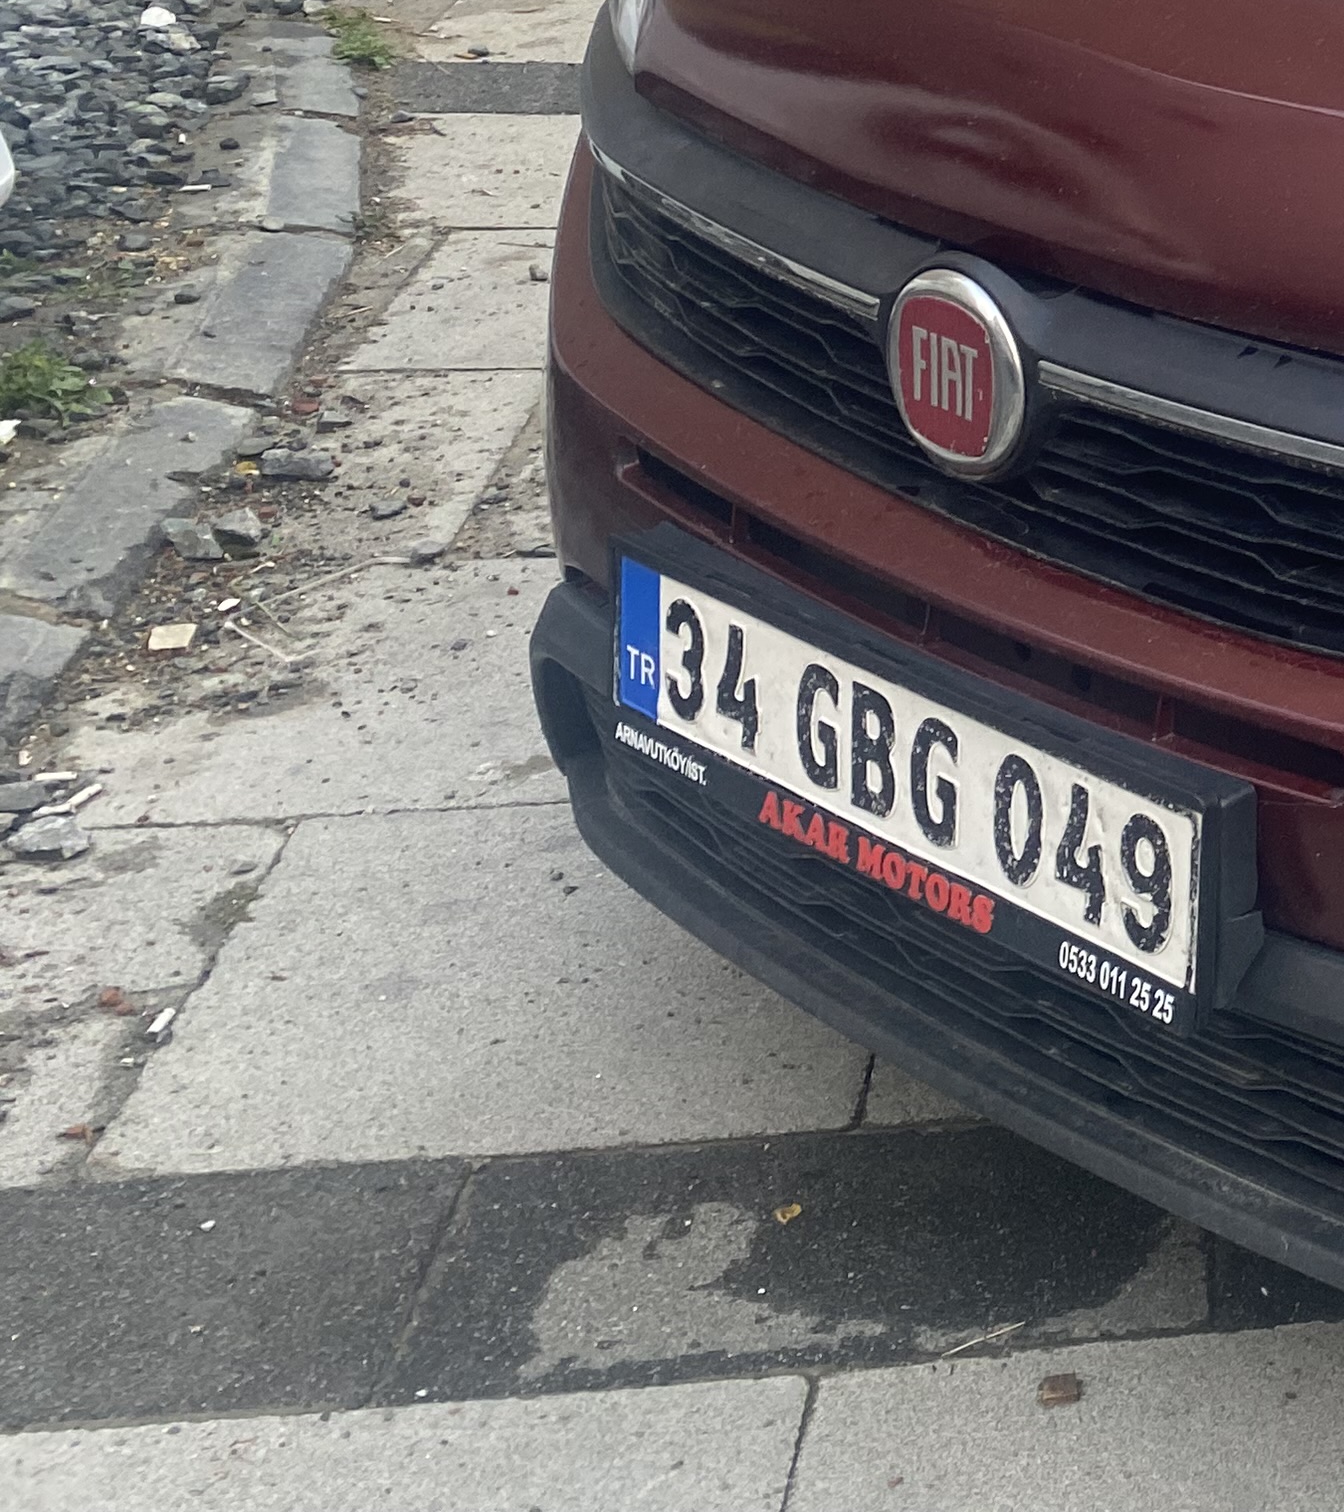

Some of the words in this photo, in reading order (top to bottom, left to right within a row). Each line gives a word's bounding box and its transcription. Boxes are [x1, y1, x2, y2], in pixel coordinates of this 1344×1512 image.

[911, 324, 979, 423] FIAT
[626, 644, 657, 690] TR
[665, 598, 760, 752] 34
[796, 662, 962, 849] GBG
[994, 752, 1174, 954] 049
[758, 790, 850, 864] AKAR
[856, 835, 996, 934] MOTORS
[1059, 940, 1097, 983] 0533
[1100, 960, 1127, 1000] 011
[1129, 976, 1152, 1012] 25
[1152, 988, 1175, 1025] 25
